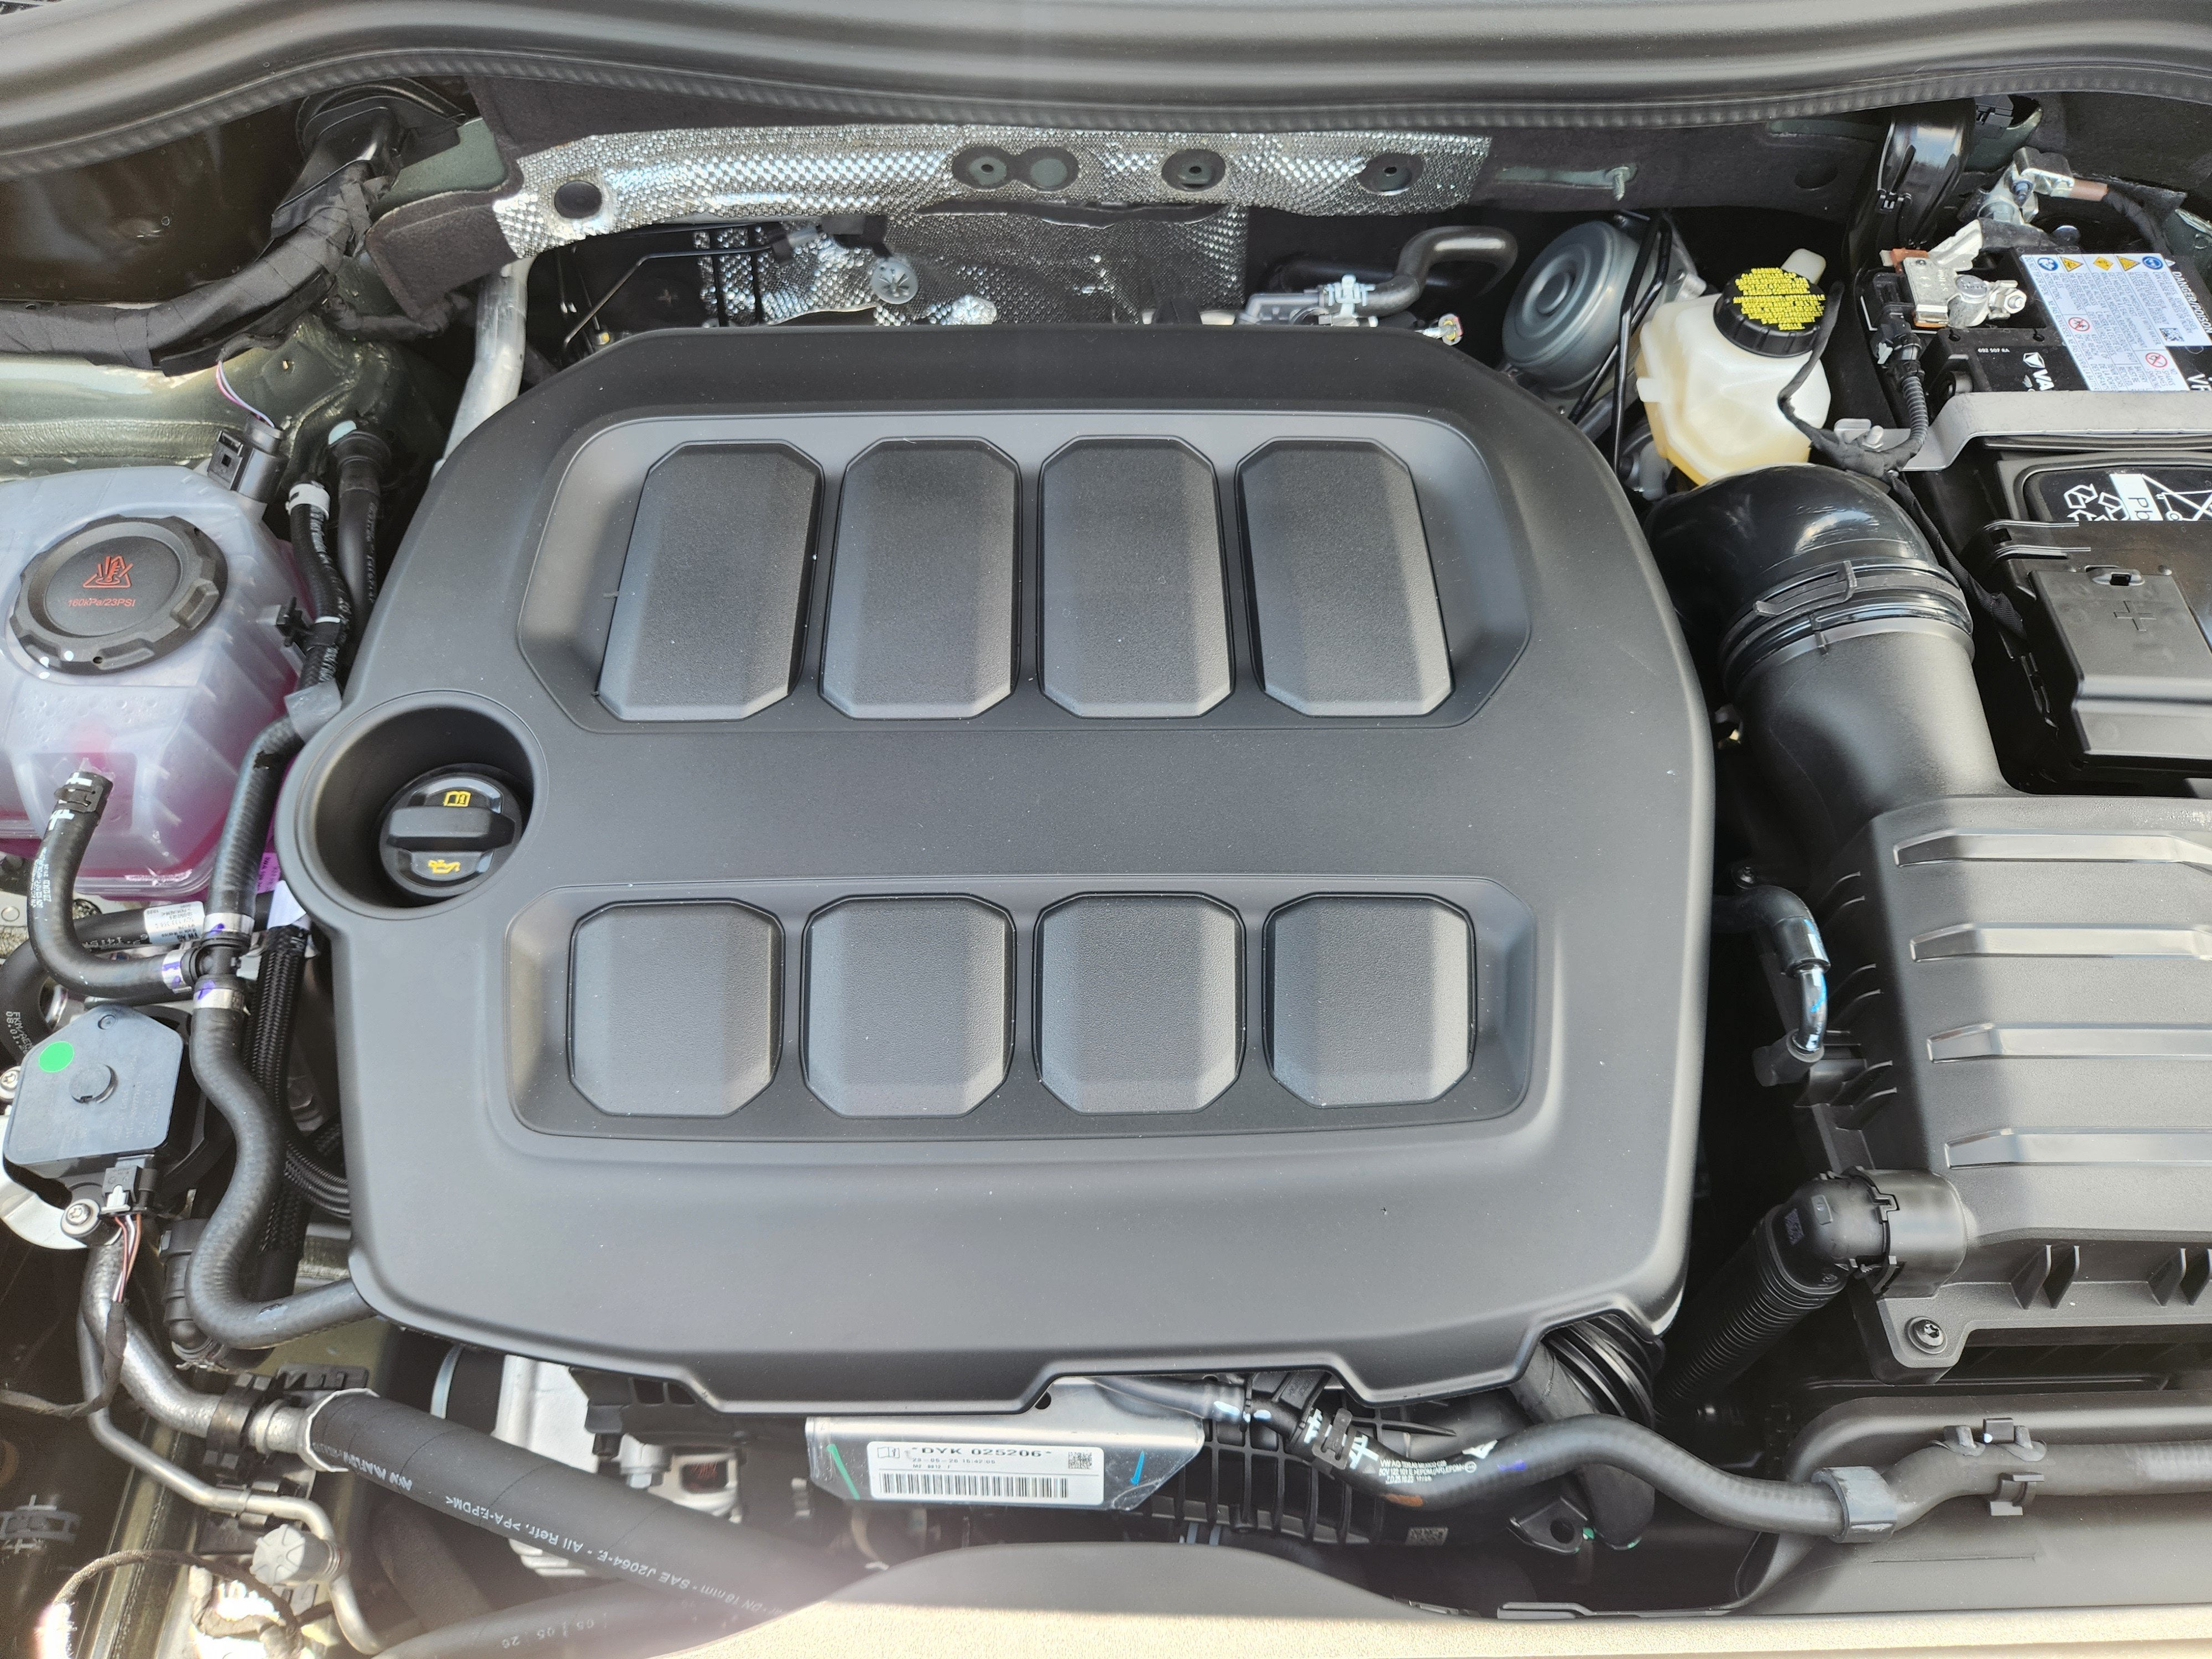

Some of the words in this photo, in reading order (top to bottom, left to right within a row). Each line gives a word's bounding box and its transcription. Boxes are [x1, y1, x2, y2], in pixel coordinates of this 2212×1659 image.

[2172, 271, 2212, 334] DANGER/POISON
[2128, 497, 2153, 520] Pb
[67, 598, 136, 607] 160kPa/23PSI
[1380, 1459, 1392, 1468] VW
[1392, 1459, 1402, 1468] AG
[659, 1572, 691, 1590] SAE
